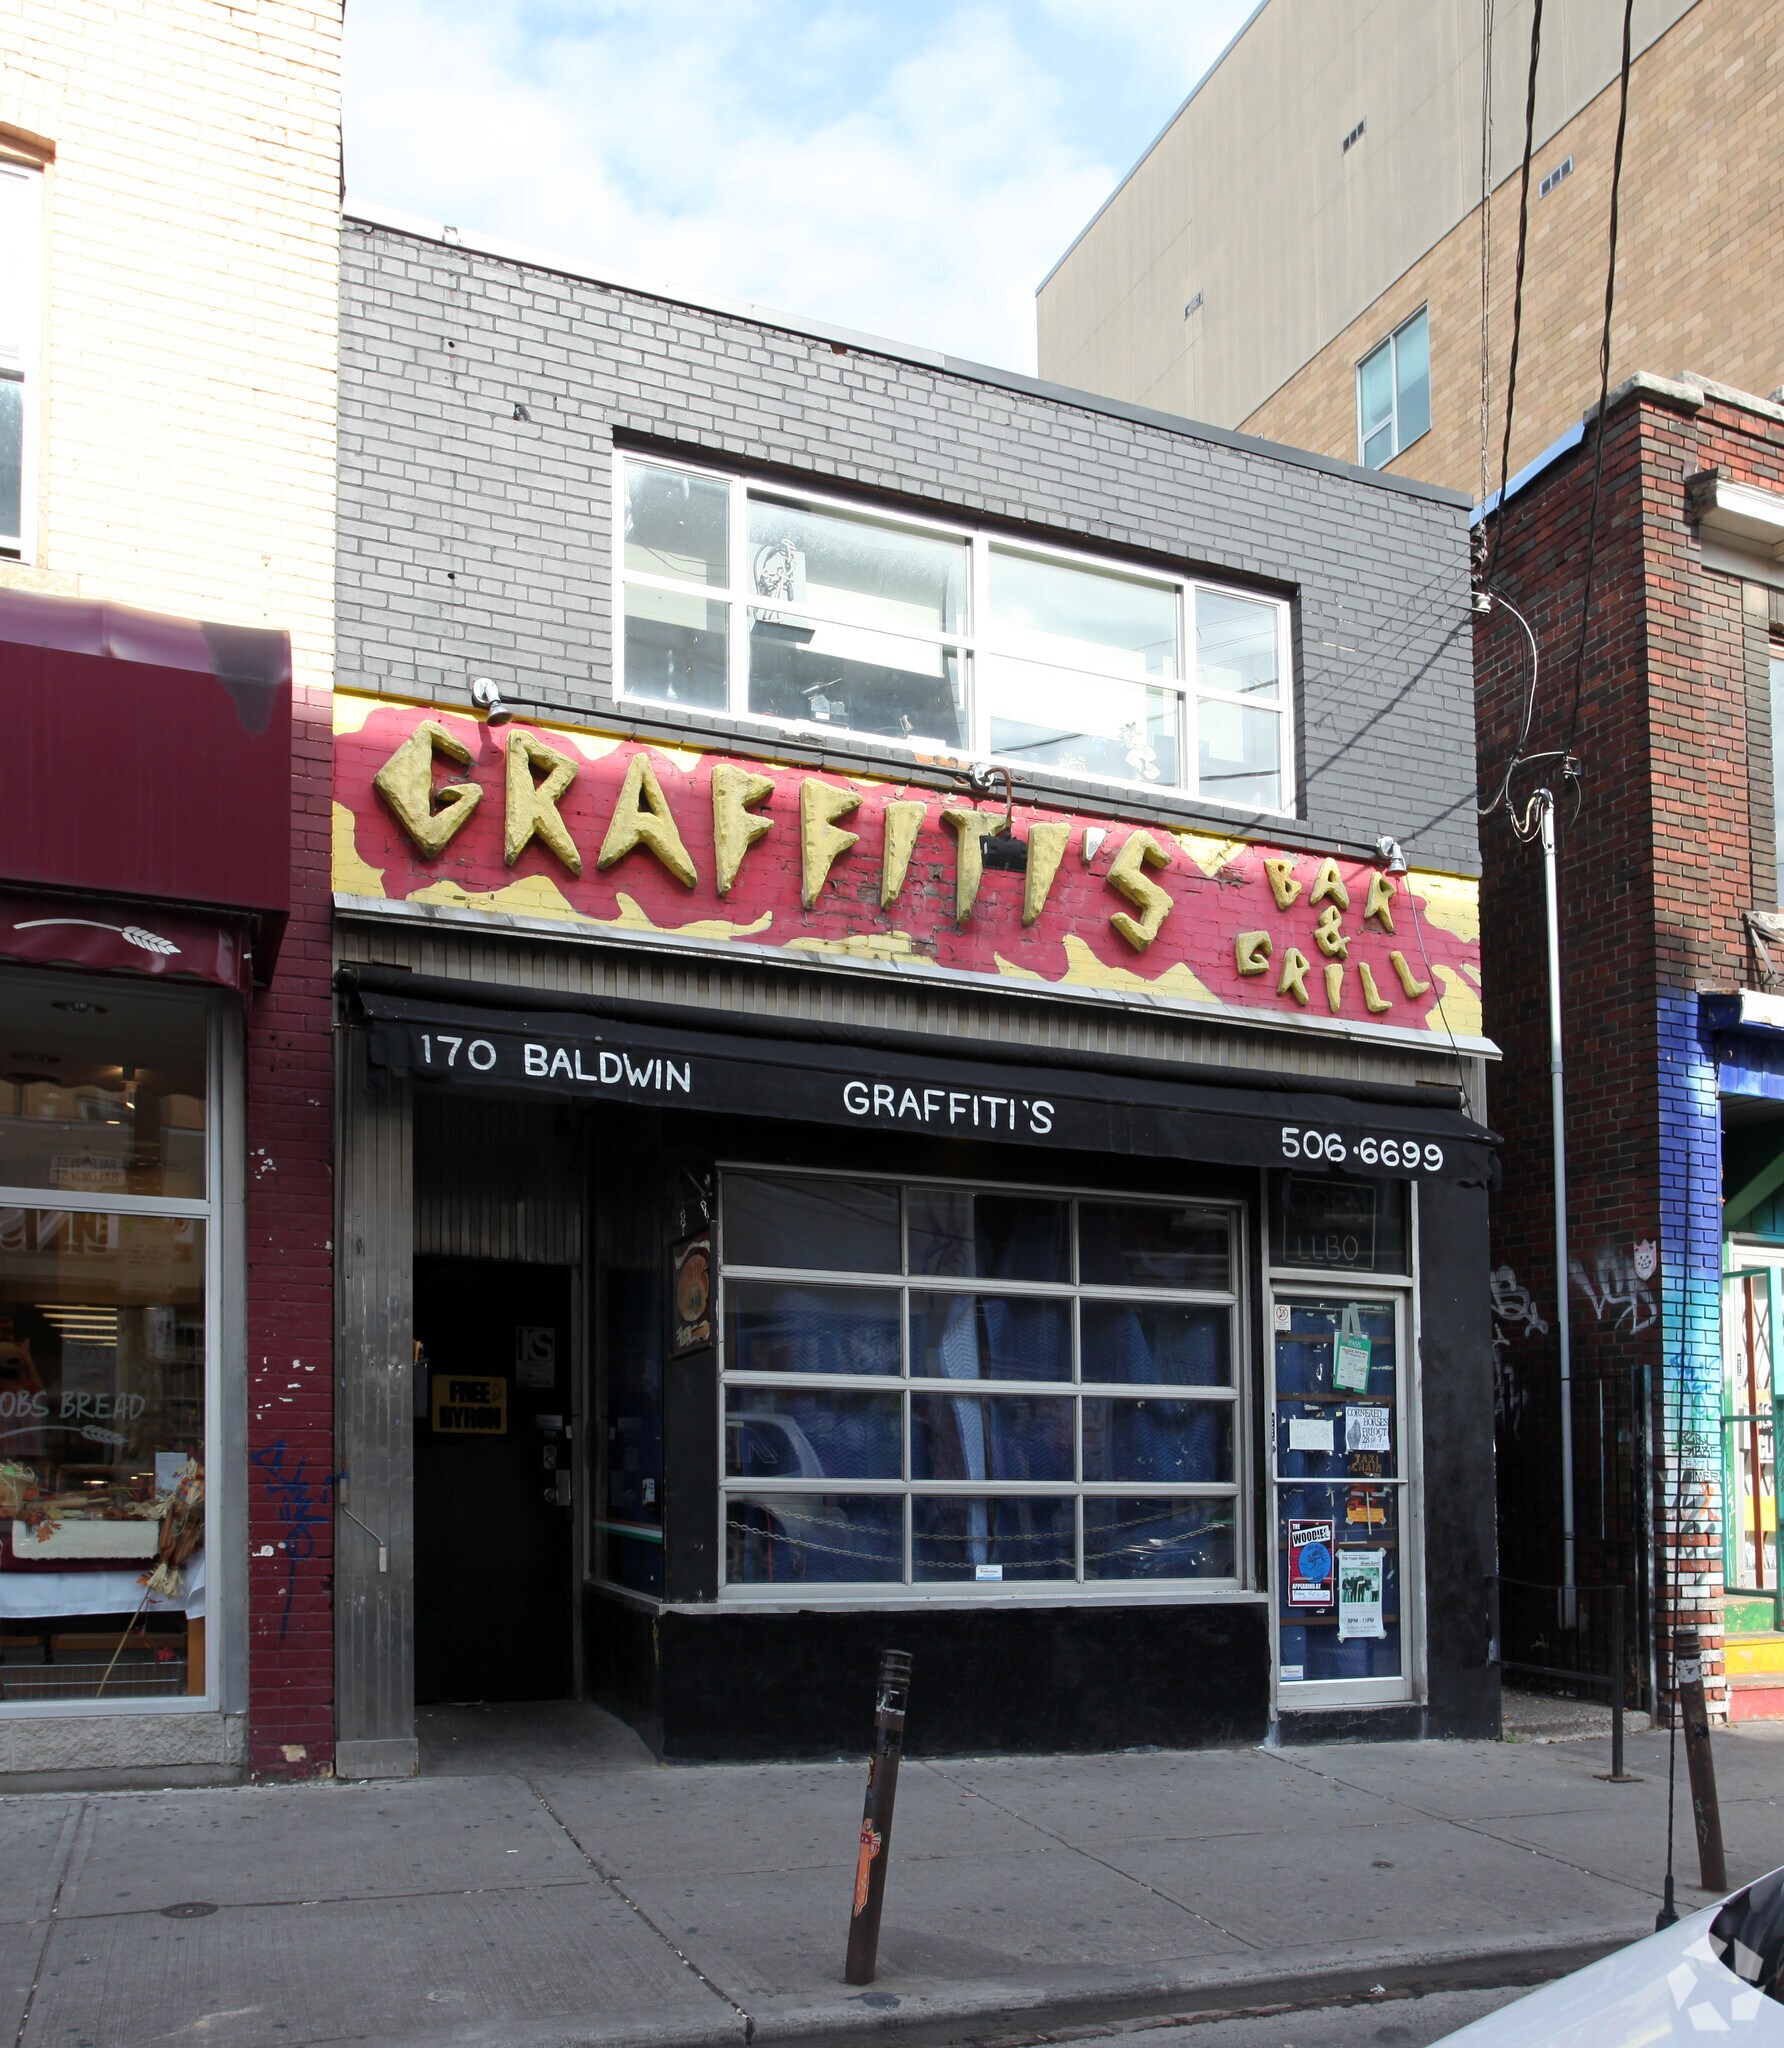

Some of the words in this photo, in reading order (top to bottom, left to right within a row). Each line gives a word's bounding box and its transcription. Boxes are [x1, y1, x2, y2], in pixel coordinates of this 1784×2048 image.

[374, 719, 1174, 952] GRAFFITI'S
[1264, 857, 1396, 933] BAR
[1315, 904, 1351, 959] &
[1236, 930, 1430, 1012] GRILL
[421, 1034, 497, 1071] 170
[524, 1043, 691, 1093] BALDWIN
[843, 1081, 1055, 1135] GRAFFITI'S
[1297, 1234, 1359, 1261] LLBO
[1348, 1340, 1362, 1348] PASS
[59, 1391, 146, 1420] BREAD
[1347, 1408, 1382, 1417] CORNERED
[1363, 1418, 1388, 1427] HORSES
[1351, 1462, 1382, 1473] CHAIN
[1354, 1453, 1379, 1463] TAXI
[1293, 1526, 1329, 1544] WOODIES
